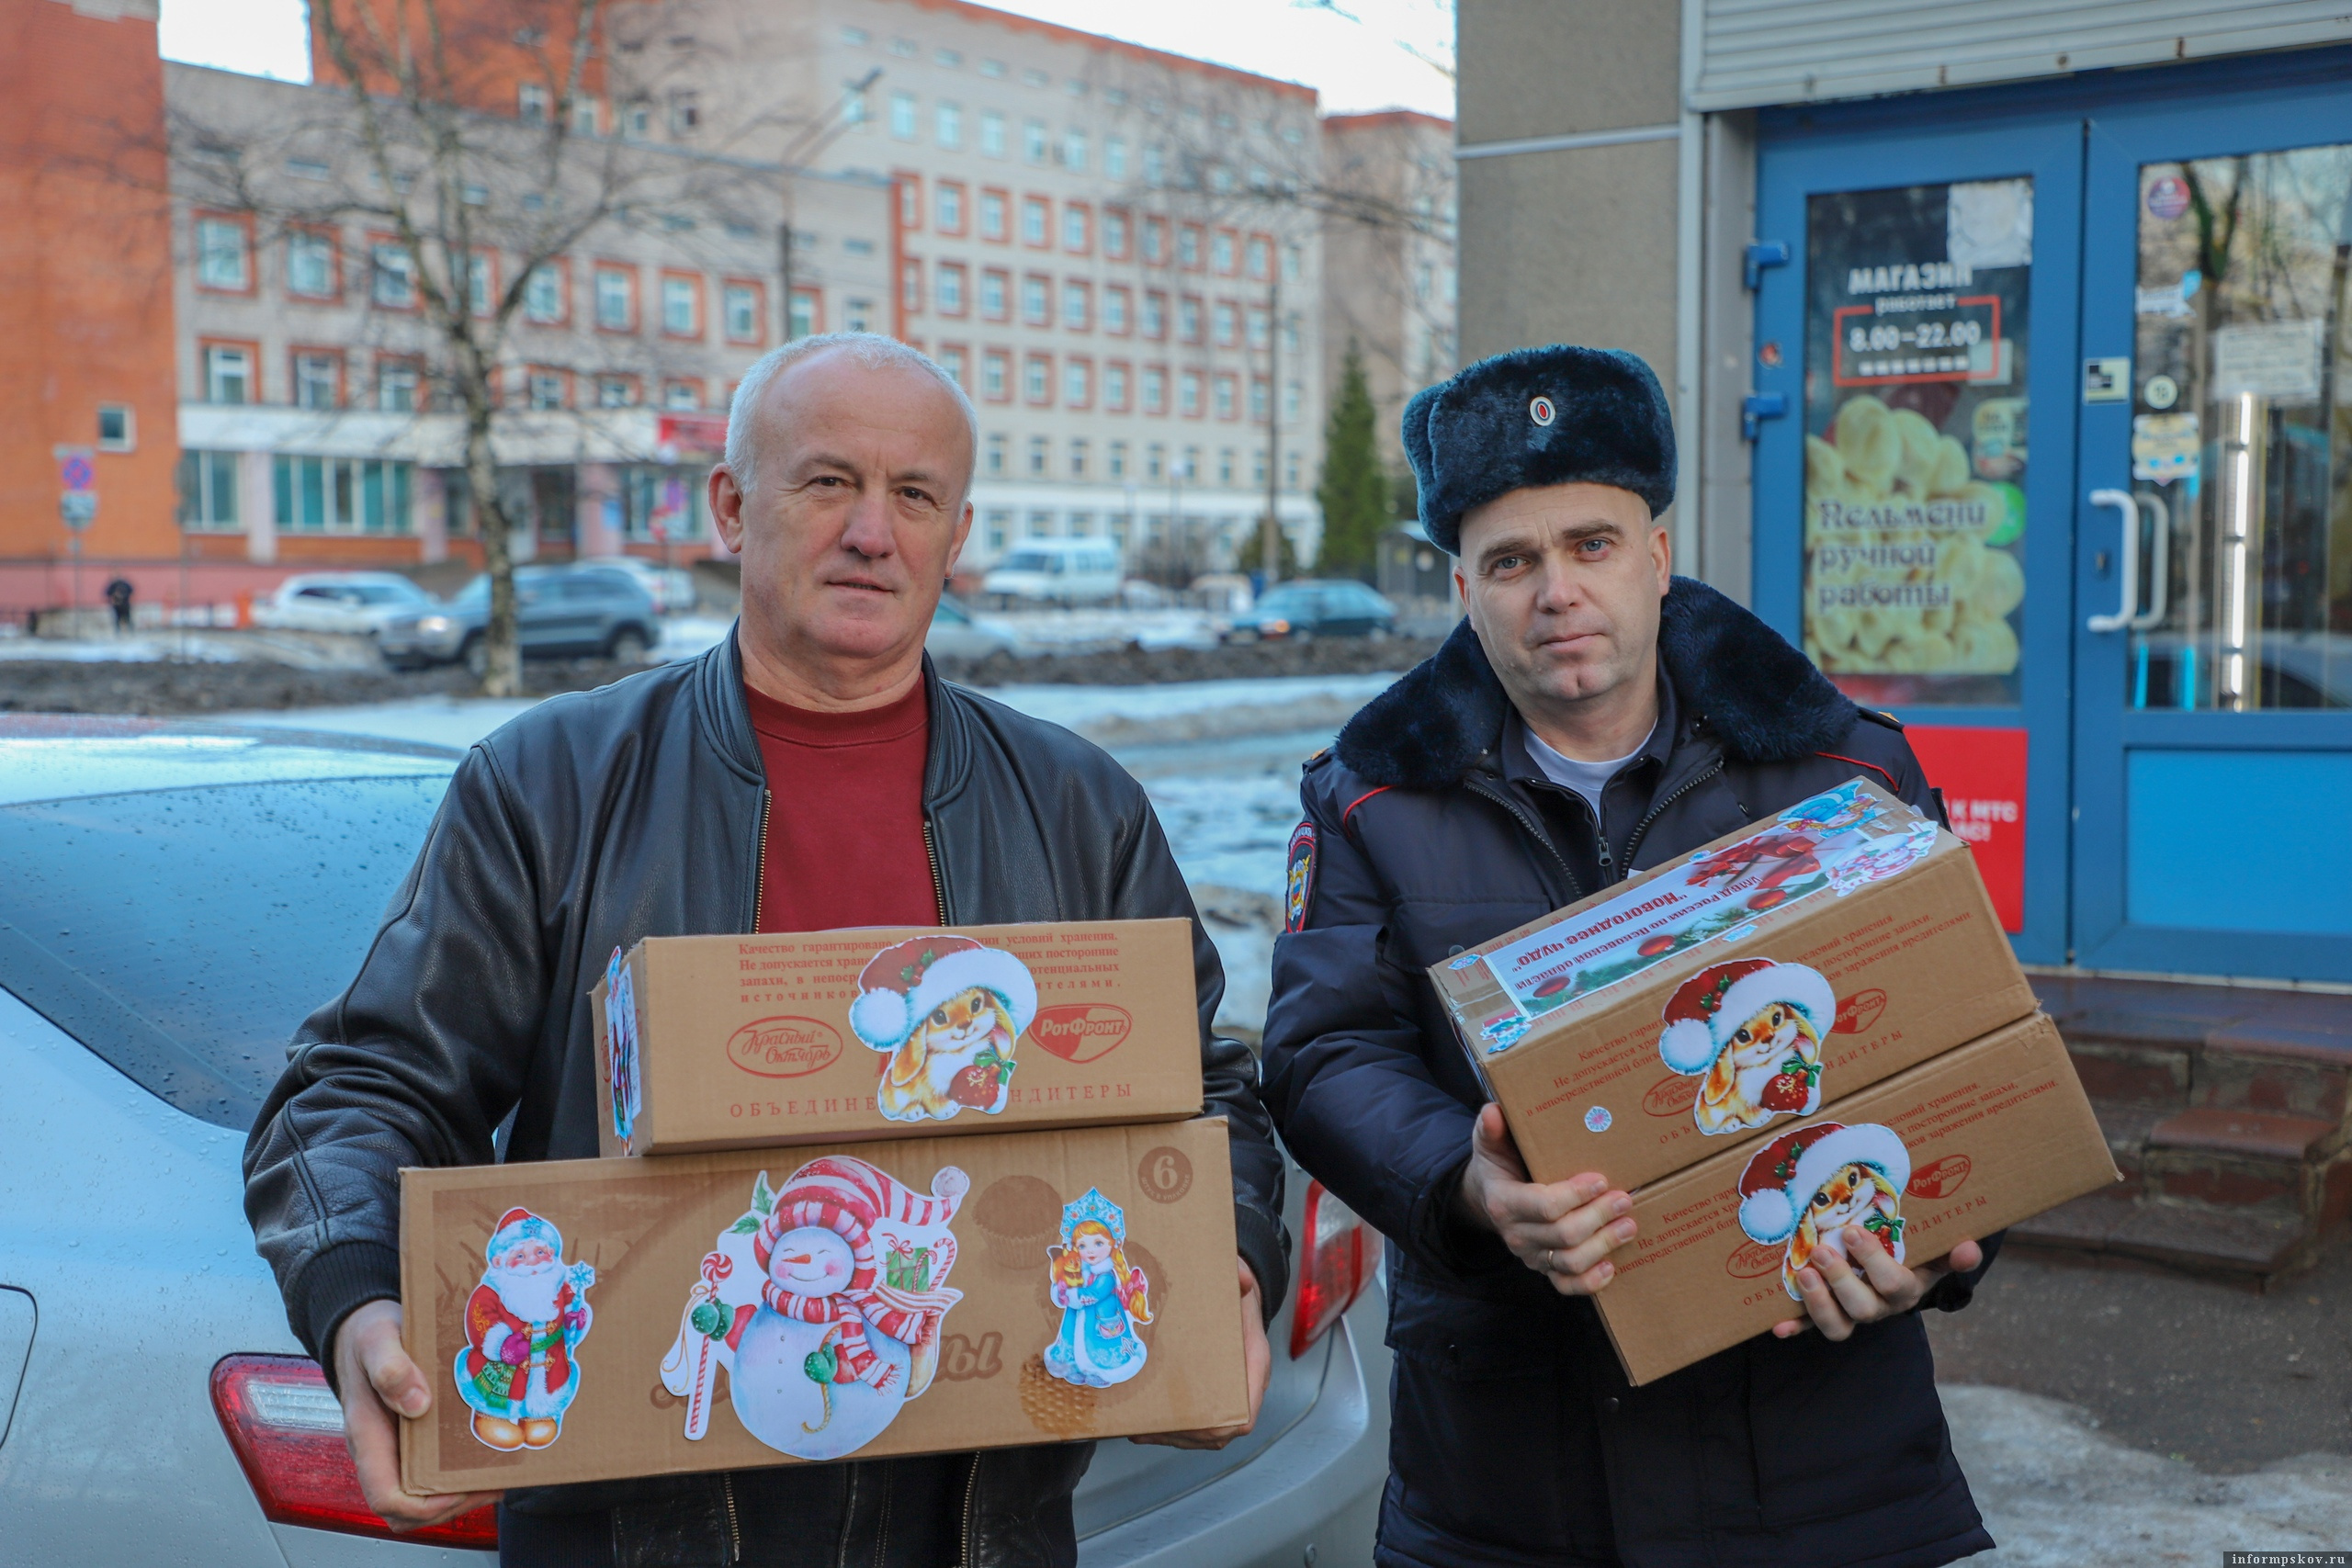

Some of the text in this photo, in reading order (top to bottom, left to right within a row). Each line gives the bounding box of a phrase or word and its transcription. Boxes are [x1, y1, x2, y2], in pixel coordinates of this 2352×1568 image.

[1819, 501, 1986, 528] Пельмени
[1819, 540, 1937, 573] ручной
[1819, 579, 1950, 613] работы
[1717, 875, 1763, 898] УМВД
[1668, 894, 1721, 921] России
[1649, 918, 1668, 930] по
[739, 941, 892, 955] Качество гарантировано
[1006, 932, 1053, 946] условий
[1060, 933, 1118, 944] хранения.
[1573, 927, 1651, 964] Псковской
[1796, 937, 1841, 964] условий
[1823, 931, 1892, 968] посторонние
[740, 960, 756, 971] Не
[760, 957, 832, 971] допускается
[1046, 947, 1119, 960] посторонние
[1844, 943, 1900, 975] заражения
[740, 975, 787, 987] запахи,
[797, 976, 804, 985] в
[1029, 963, 1120, 976] отенциальных
[1514, 960, 1573, 990] области
[1035, 979, 1121, 990] ителями.
[1837, 995, 1884, 1023] отФронт
[1577, 1032, 1627, 1062] Качество
[1825, 1030, 1904, 1071] НДИТЕРЫ
[1553, 1075, 1569, 1089] Не
[1572, 1047, 1636, 1082] допускается
[1010, 1084, 1132, 1104] НДИТЕРЫ
[1535, 1063, 1632, 1114] непосредственной
[730, 1096, 876, 1118] ОБЪЕДИНЕ
[1882, 1102, 1927, 1127] условий
[1906, 1100, 1976, 1134] посторонние
[1928, 1079, 2059, 1141] заражения вредителями.
[1153, 1155, 1178, 1190] 6
[1662, 1199, 1712, 1224] Качество
[1906, 1196, 1988, 1235] НДИТЕРЫ
[1637, 1239, 1654, 1250] Не
[1656, 1209, 1720, 1244] допускается
[1619, 1226, 1715, 1274] непосредственной
